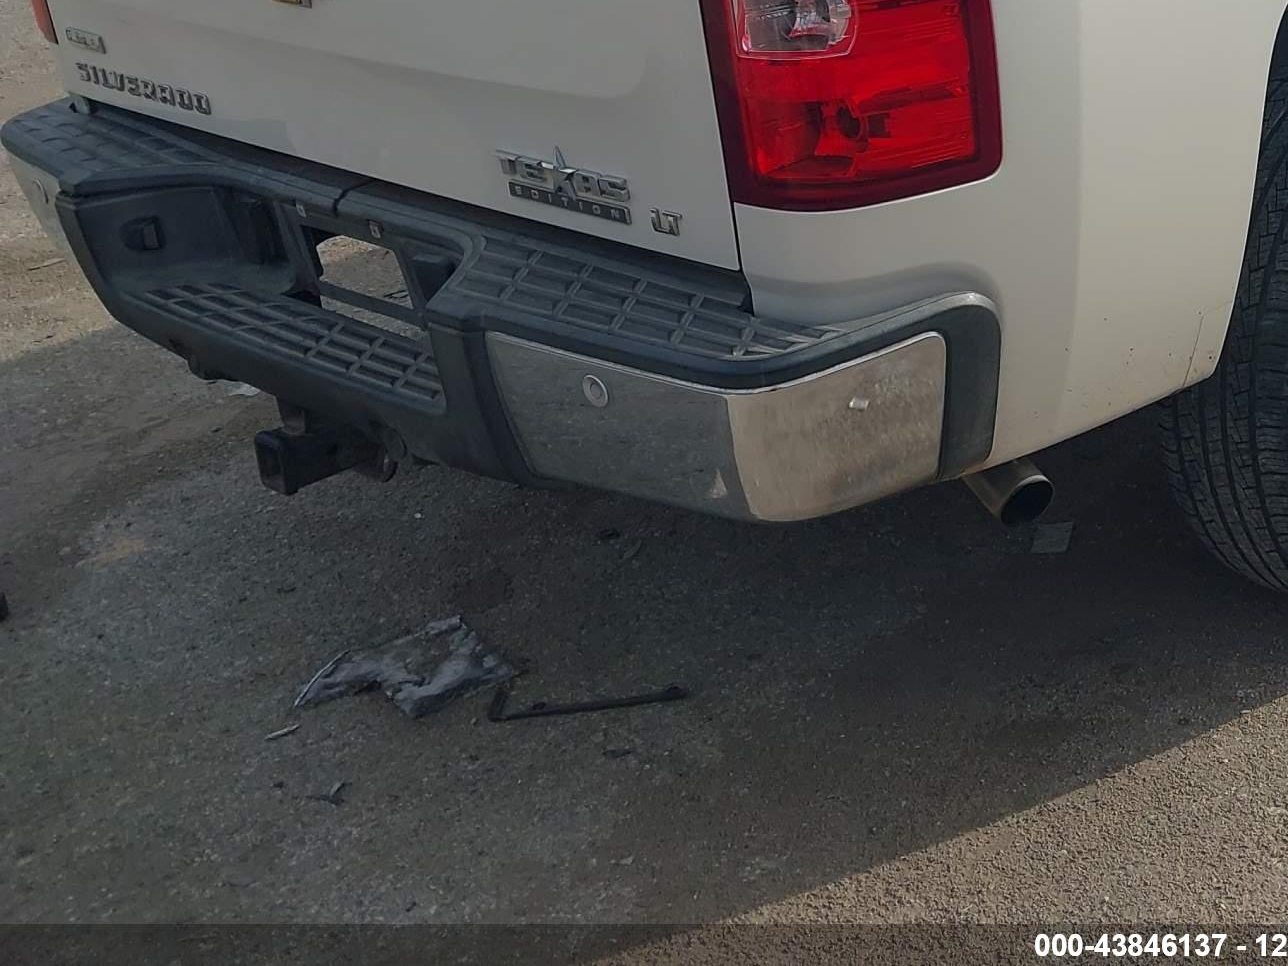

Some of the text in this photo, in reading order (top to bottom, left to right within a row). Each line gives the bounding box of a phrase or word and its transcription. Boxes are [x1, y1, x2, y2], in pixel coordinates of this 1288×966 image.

[75, 62, 212, 115] SILVERADO
[496, 145, 630, 203] TEXAS
[512, 184, 623, 220] EDITION
[649, 207, 682, 237] LT
